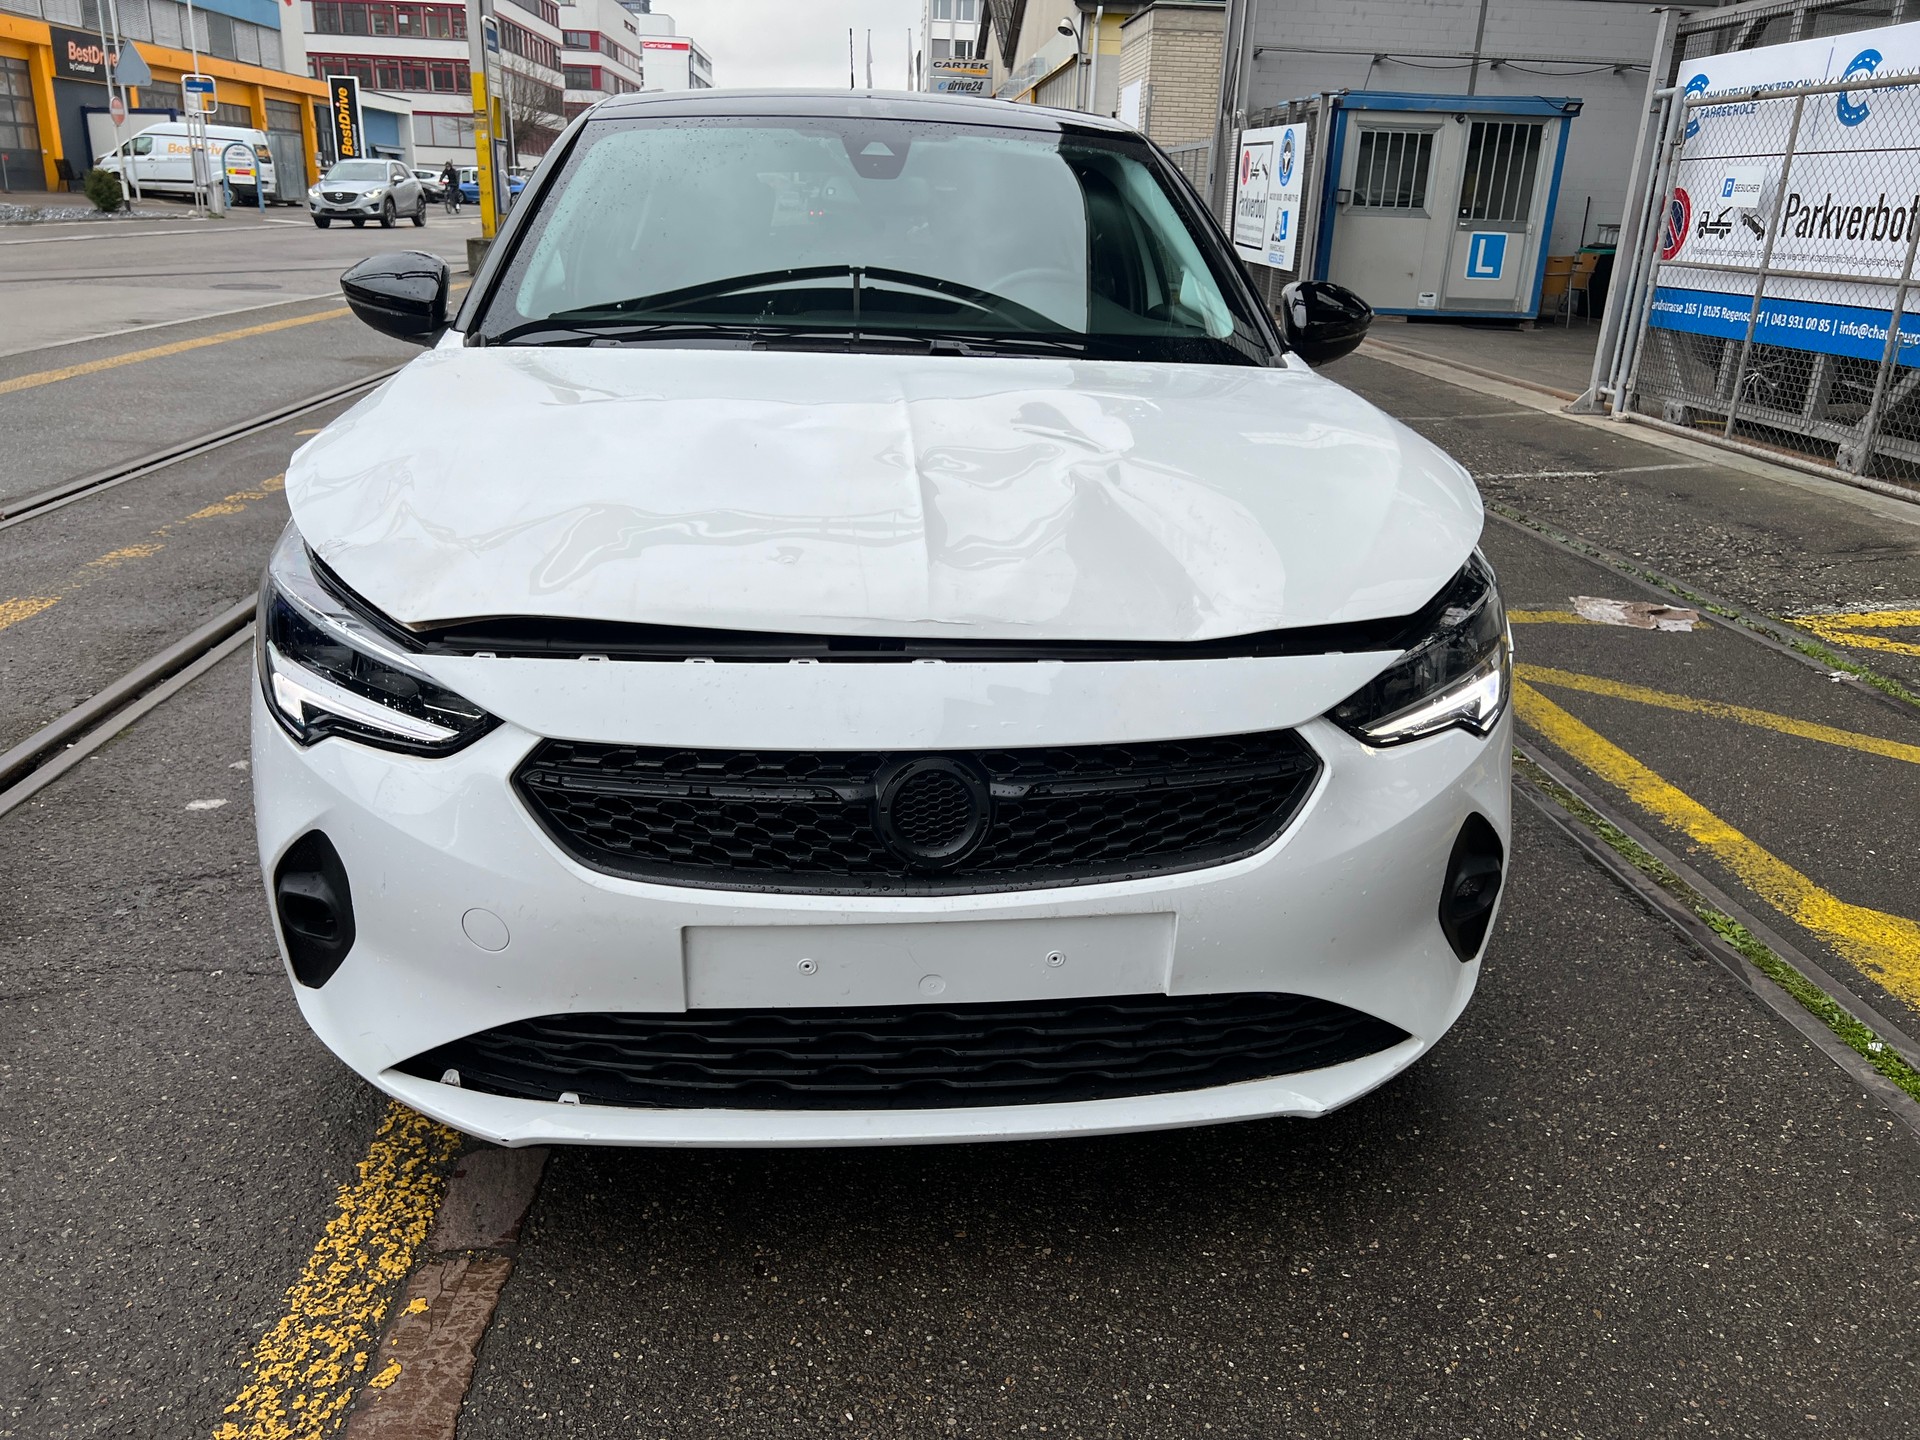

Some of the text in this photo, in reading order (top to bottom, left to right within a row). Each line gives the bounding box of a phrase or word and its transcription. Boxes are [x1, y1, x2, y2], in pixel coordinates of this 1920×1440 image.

[68, 41, 118, 67] BestDrve
[933, 61, 989, 69] CARTEK
[335, 87, 354, 156] BestDrive
[168, 143, 222, 155] Besiv
[1781, 193, 1920, 242] Parkverbot
[1475, 238, 1494, 274] L
[1652, 299, 1684, 314] ardstrasse
[1702, 304, 1721, 318] 8105
[1721, 306, 1764, 324] Regensrf
[1770, 312, 1787, 327] 043
[1787, 314, 1804, 329] 931
[1805, 317, 1818, 331] 00
[1819, 318, 1832, 333] 85
